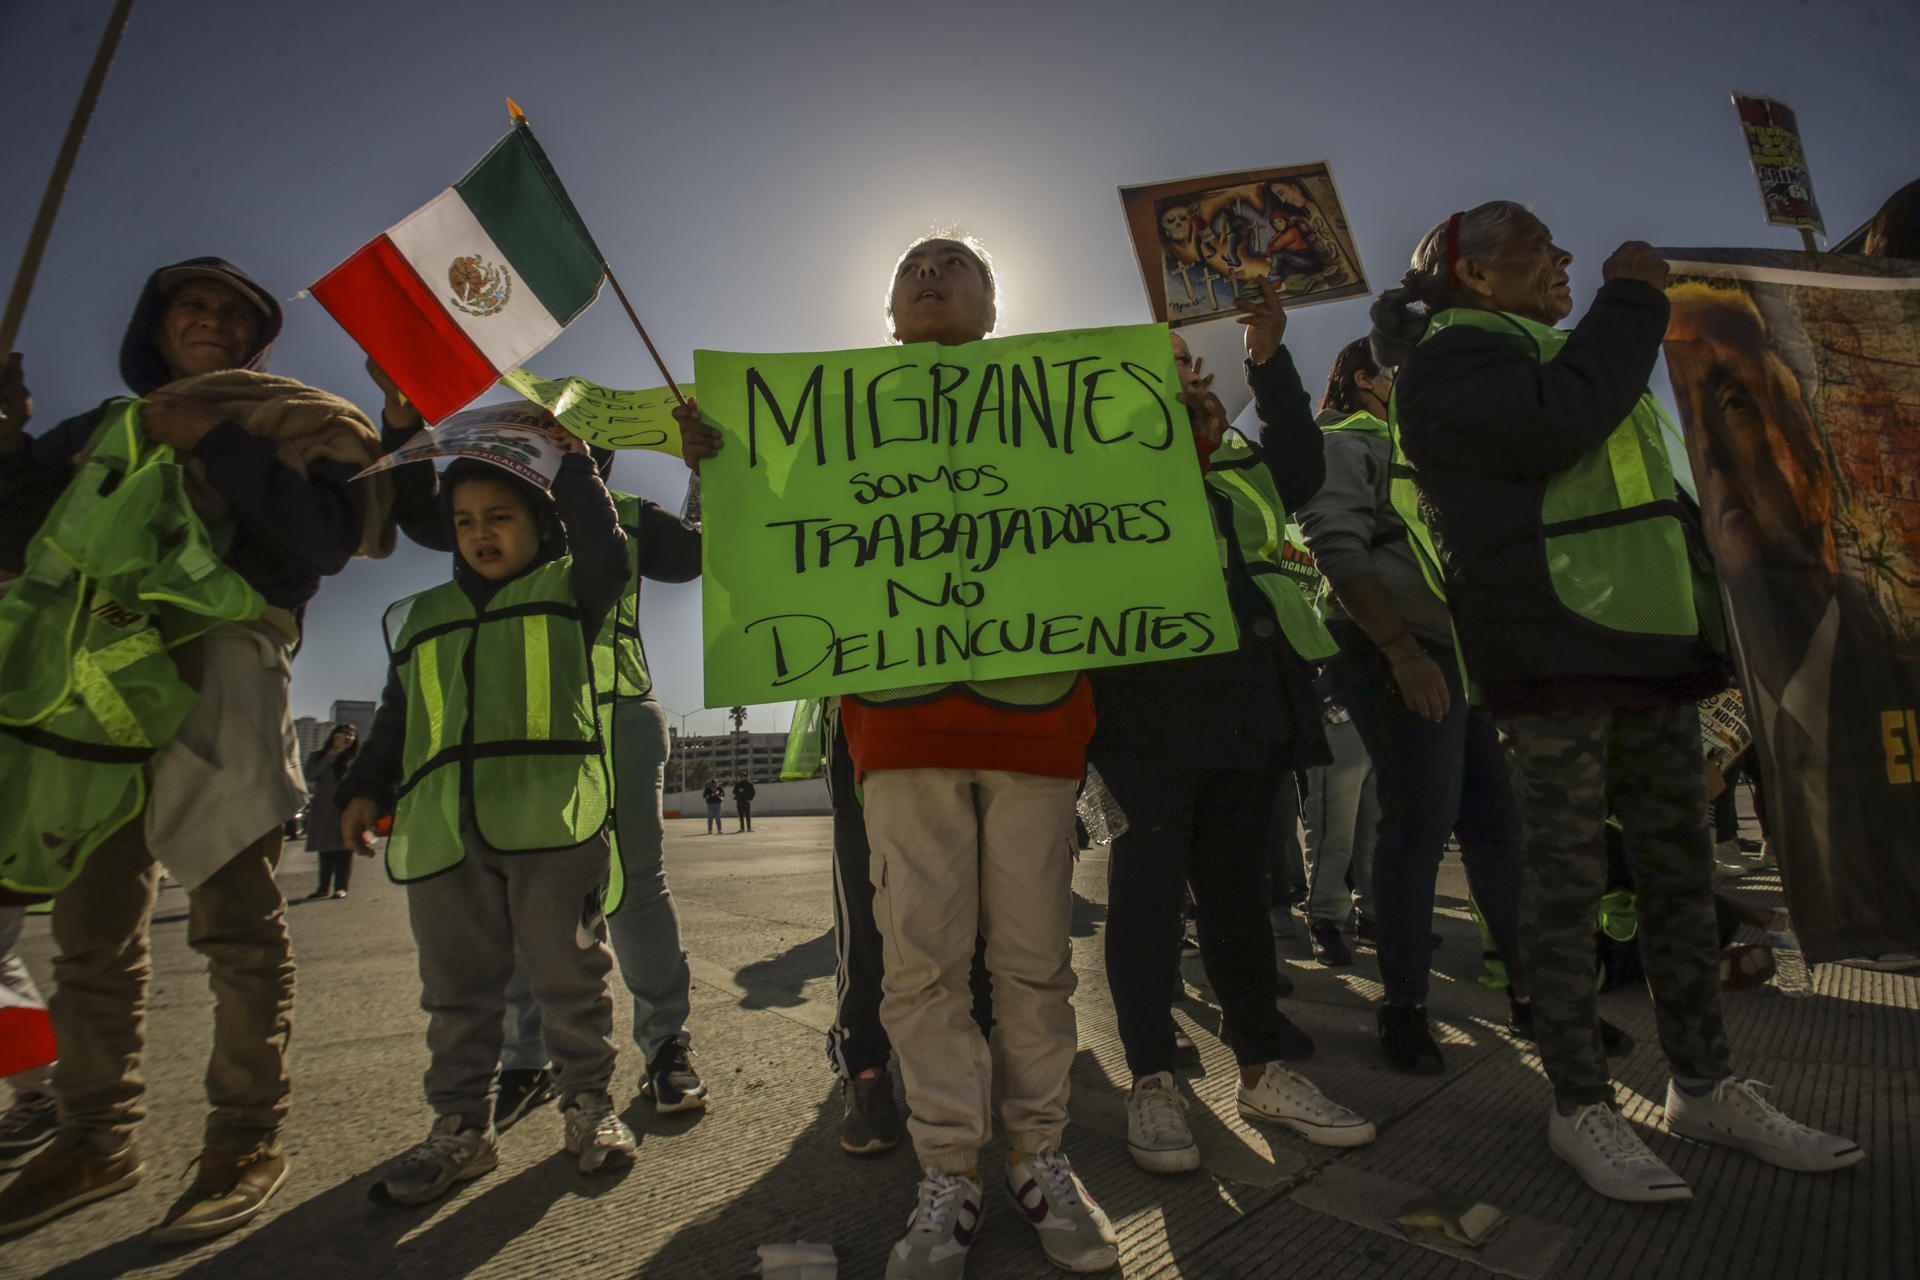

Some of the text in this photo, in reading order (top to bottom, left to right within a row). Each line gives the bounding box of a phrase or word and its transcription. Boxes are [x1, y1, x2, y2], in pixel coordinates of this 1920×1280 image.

[746, 356, 1175, 468] MIGRANTES
[849, 464, 1008, 504] SOMOS
[765, 499, 1171, 574] TRABAJADORES
[886, 572, 985, 618] NO
[744, 606, 1216, 687] DELINCUENTES
